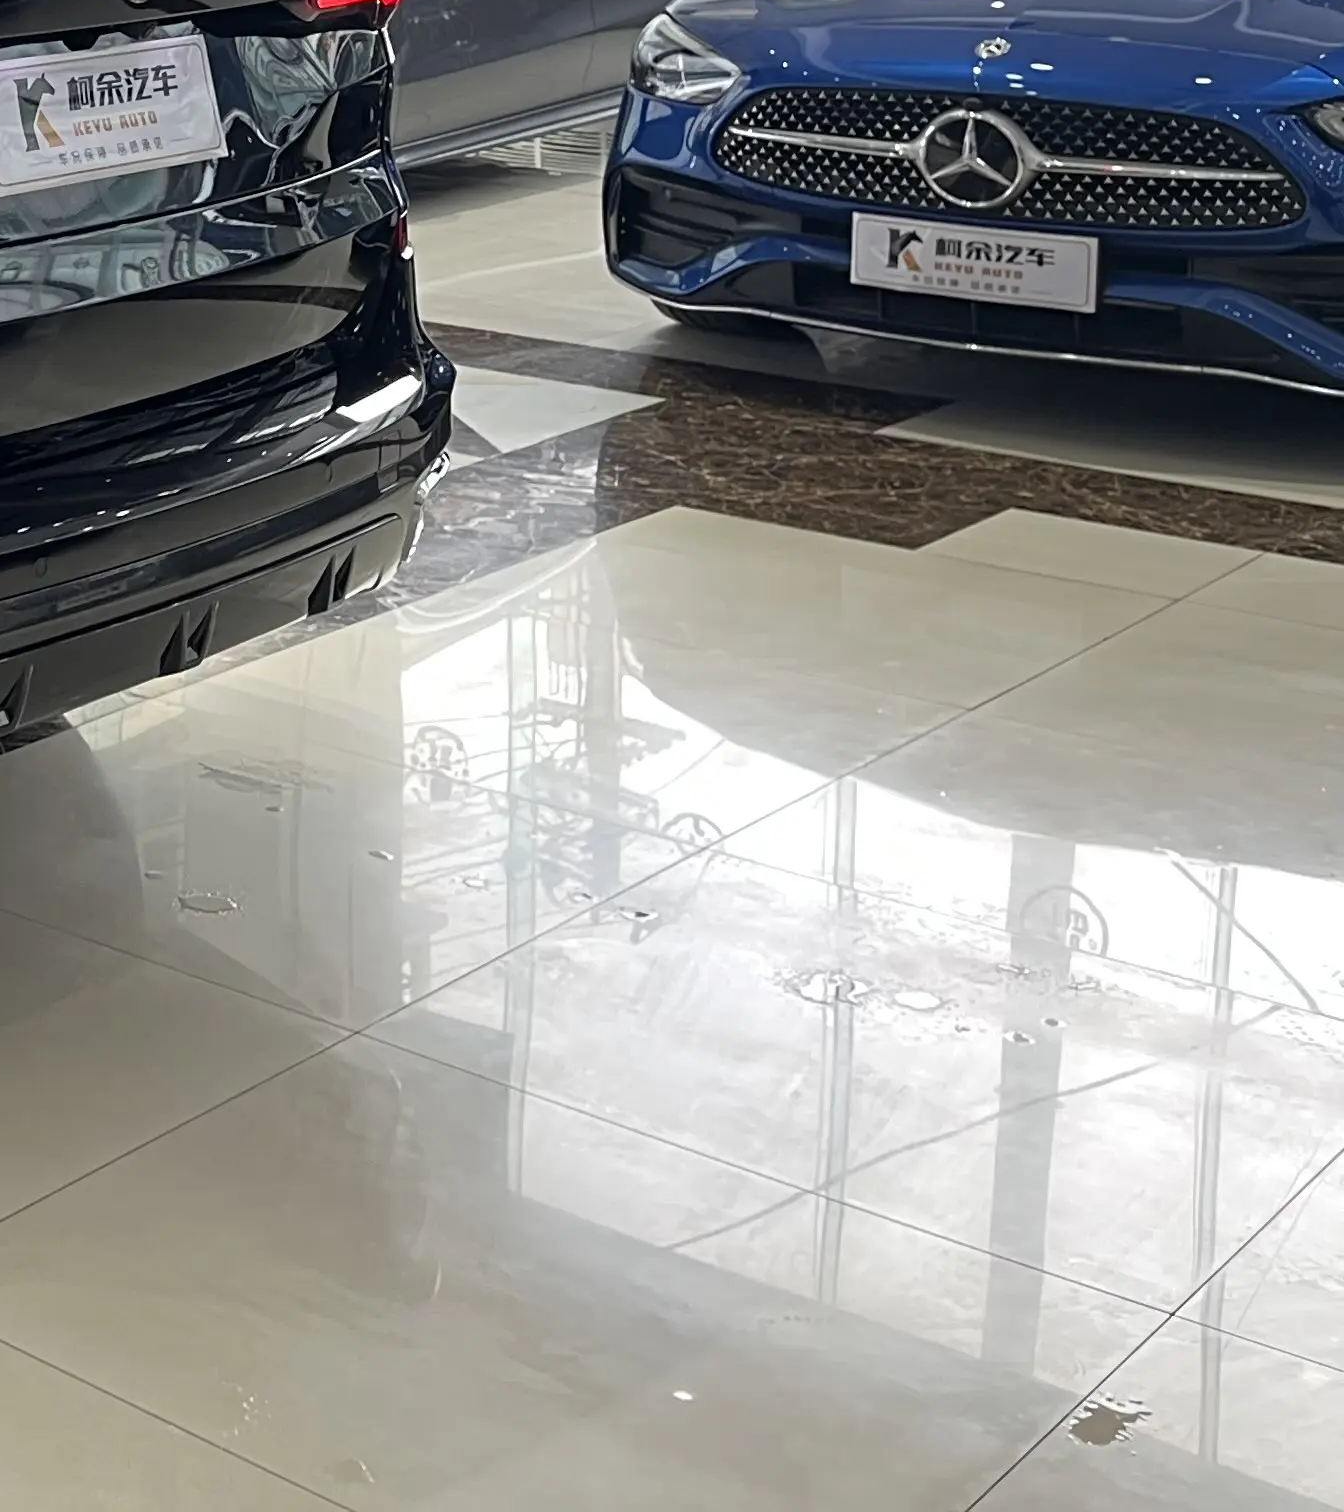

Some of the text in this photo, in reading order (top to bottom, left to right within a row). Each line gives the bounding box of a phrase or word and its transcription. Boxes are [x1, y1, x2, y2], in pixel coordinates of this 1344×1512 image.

[67, 64, 178, 112] 柯余汽车
[73, 110, 158, 136] KEYU AUTO
[935, 237, 1056, 267] 柯余汽车
